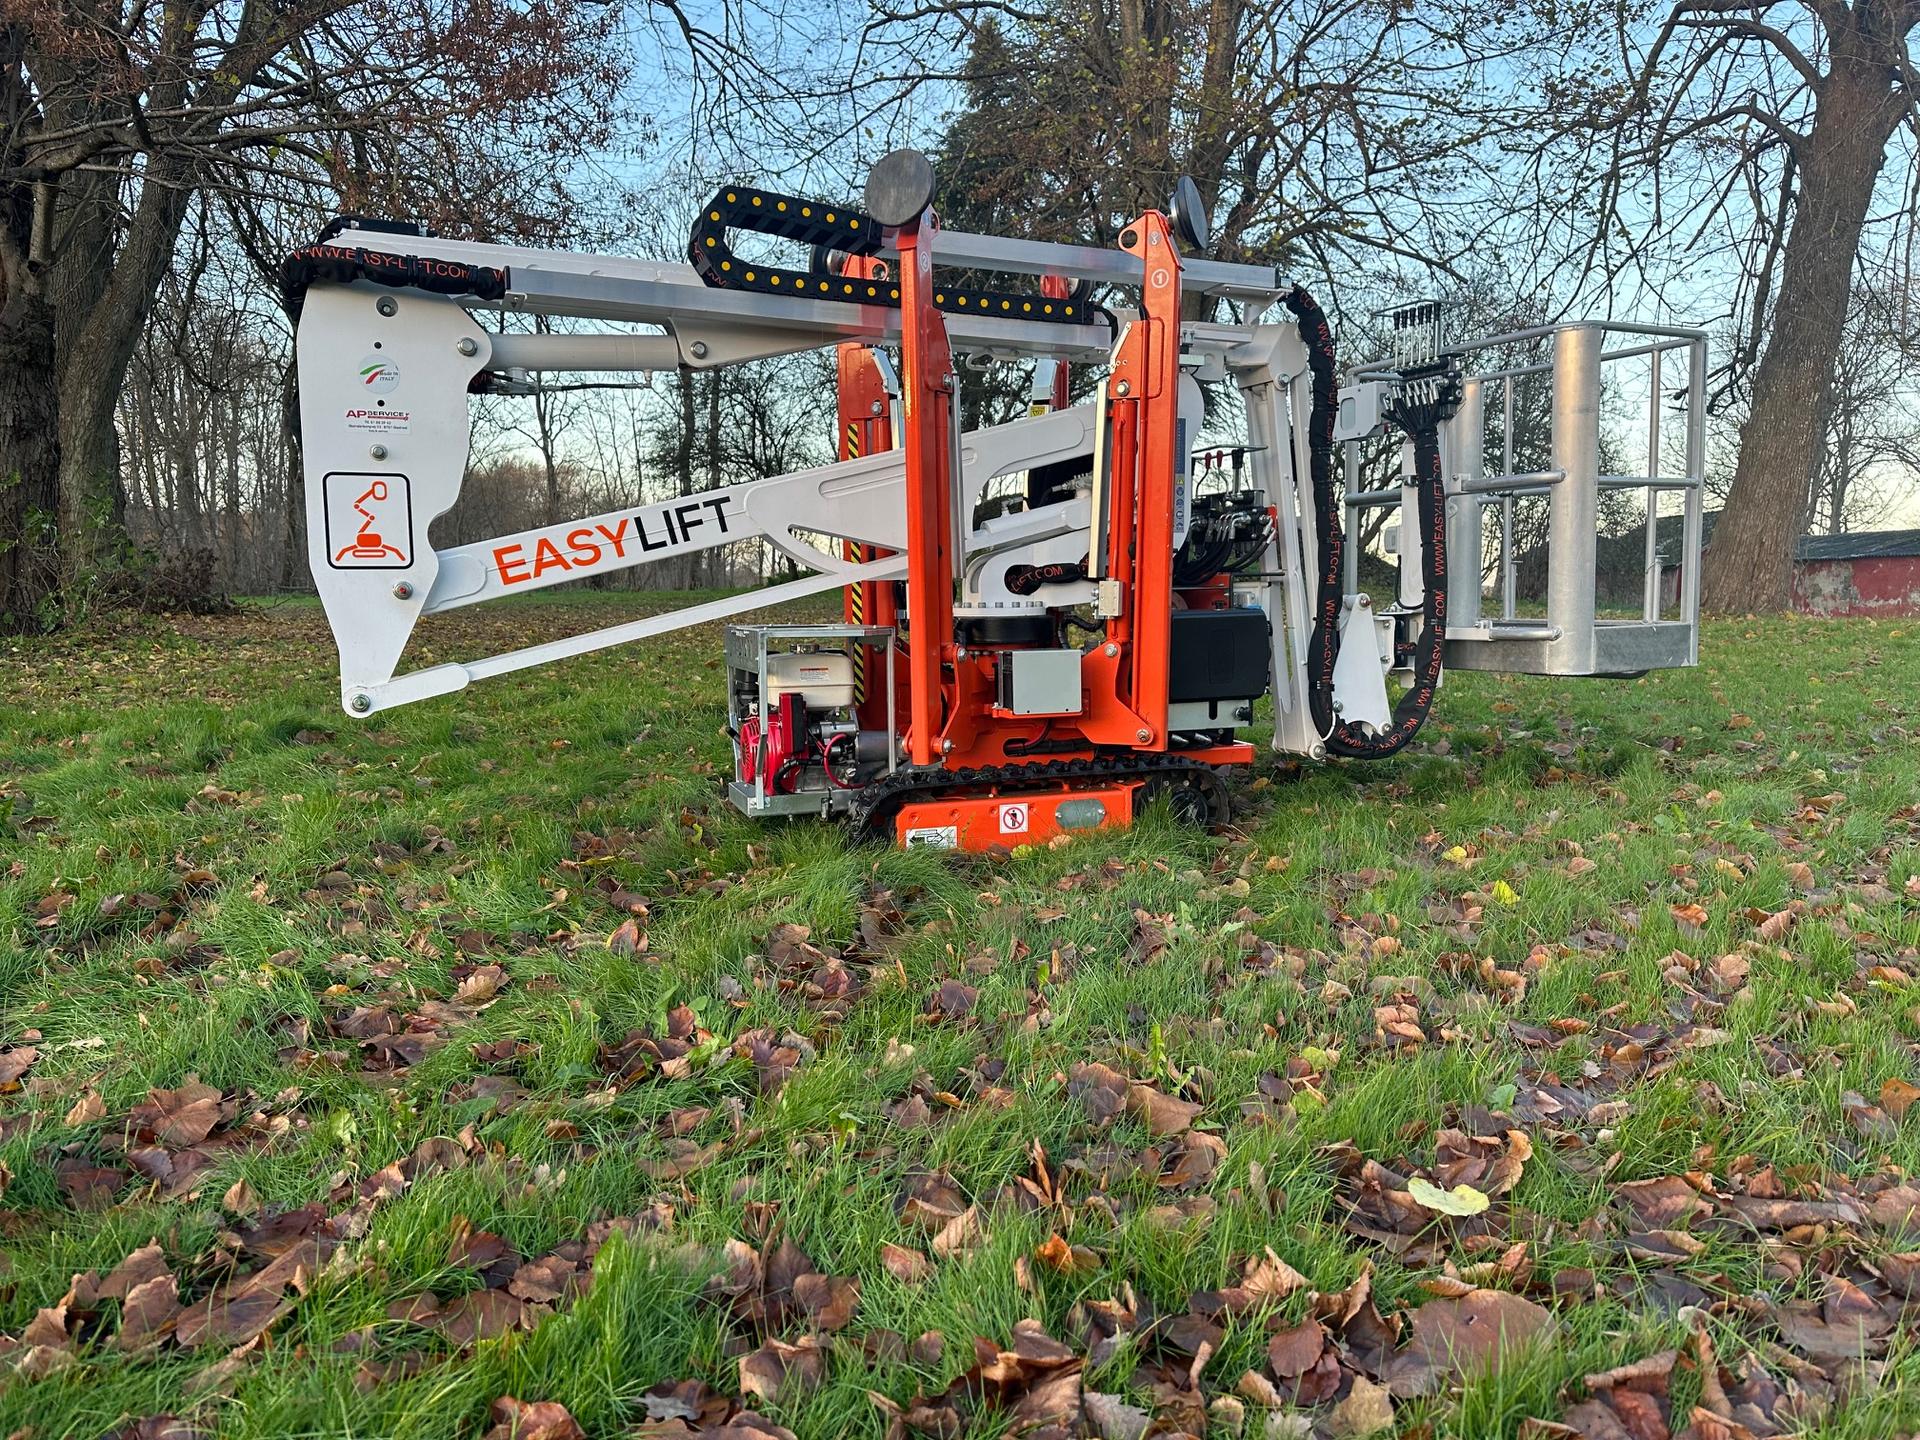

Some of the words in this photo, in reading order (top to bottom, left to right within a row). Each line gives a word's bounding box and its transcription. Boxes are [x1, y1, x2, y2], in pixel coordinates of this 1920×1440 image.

[292, 246, 469, 279] WWW.ESY-LIFT.COM
[346, 409, 367, 418] AP
[492, 496, 731, 586] EASYLIFT
[1432, 454, 1445, 576] WWWEASY-LIFT.COM
